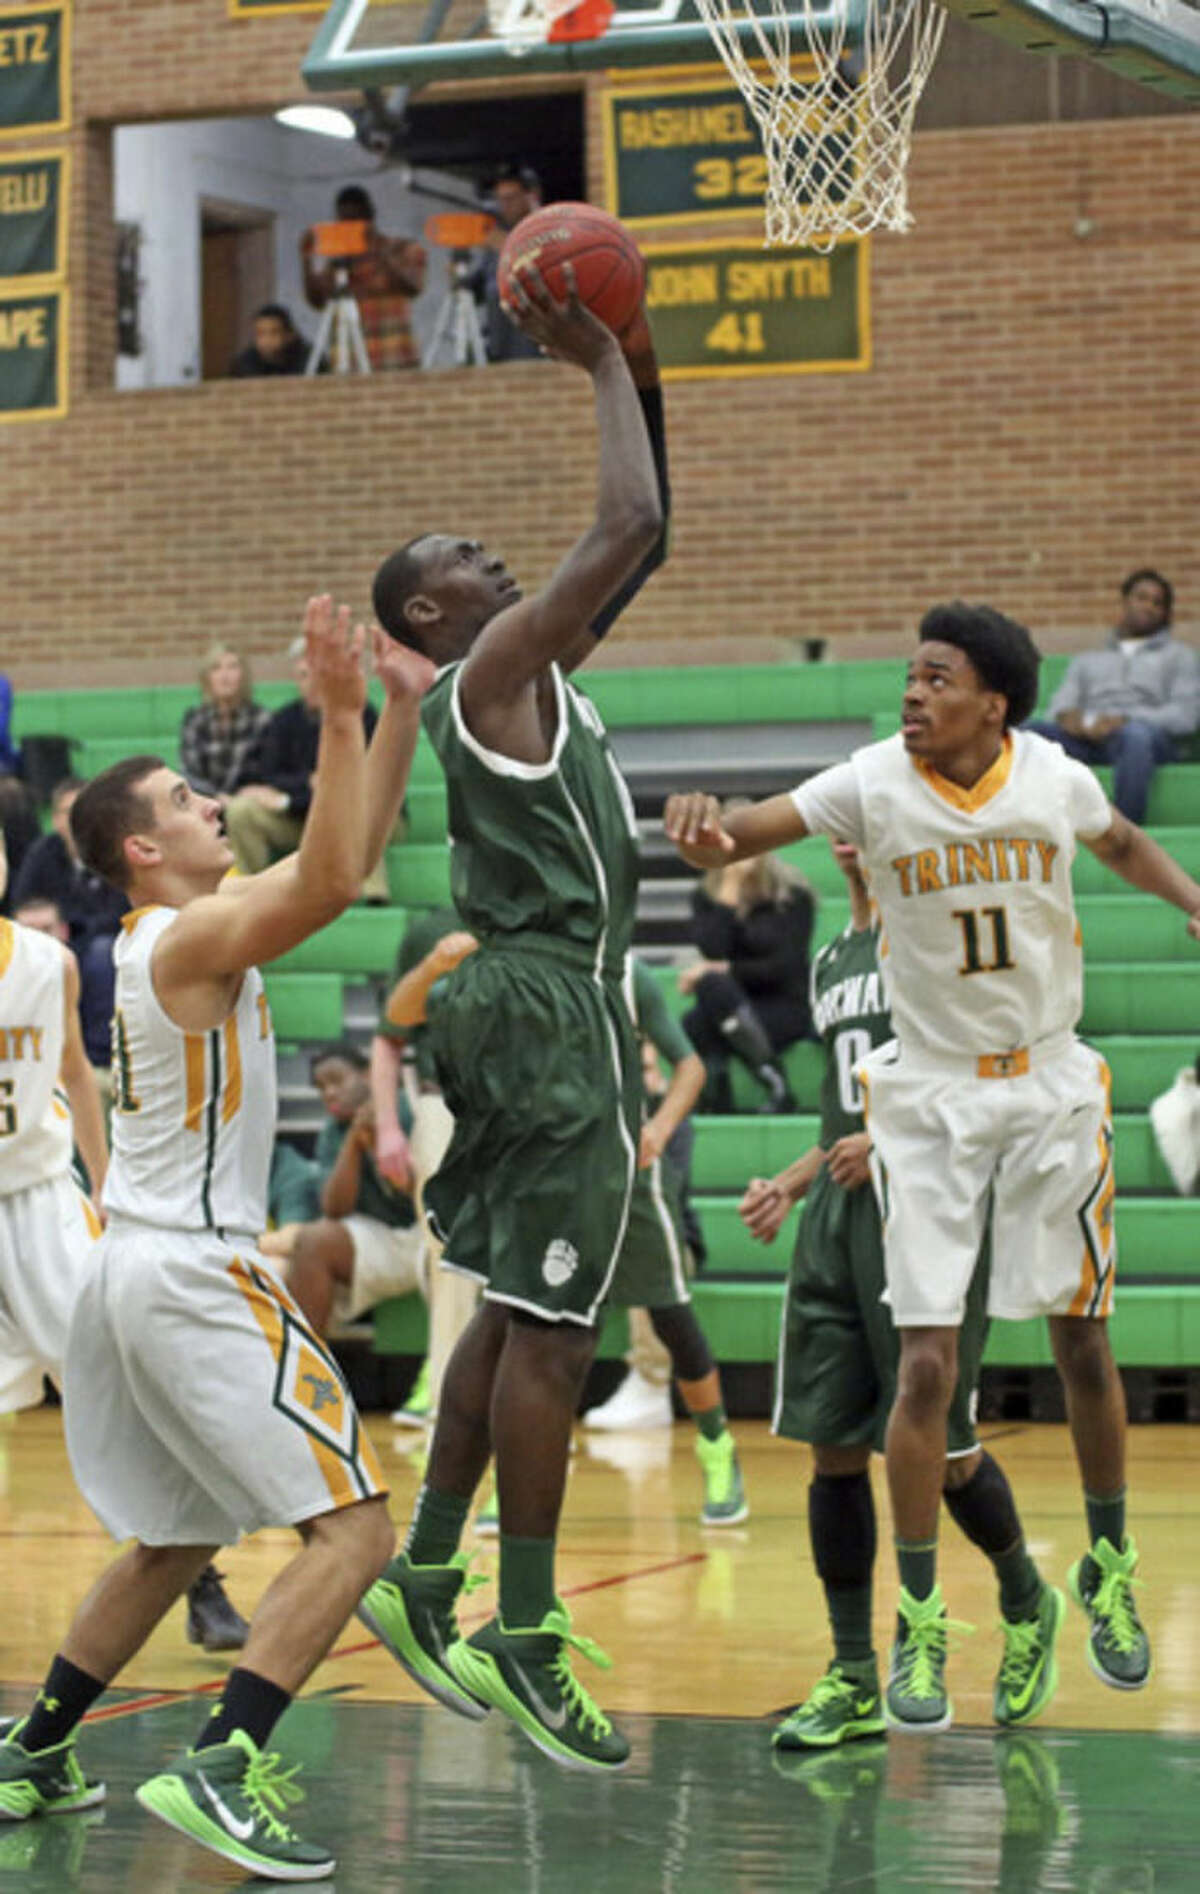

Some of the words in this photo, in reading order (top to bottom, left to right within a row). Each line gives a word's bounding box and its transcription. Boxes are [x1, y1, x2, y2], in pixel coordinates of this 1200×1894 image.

[693, 155, 768, 199] 32
[645, 263, 718, 308] JOHN
[727, 257, 830, 302] SMYTH
[706, 311, 766, 353] 41
[892, 837, 1059, 897] TRINITY
[952, 906, 1016, 976] 11
